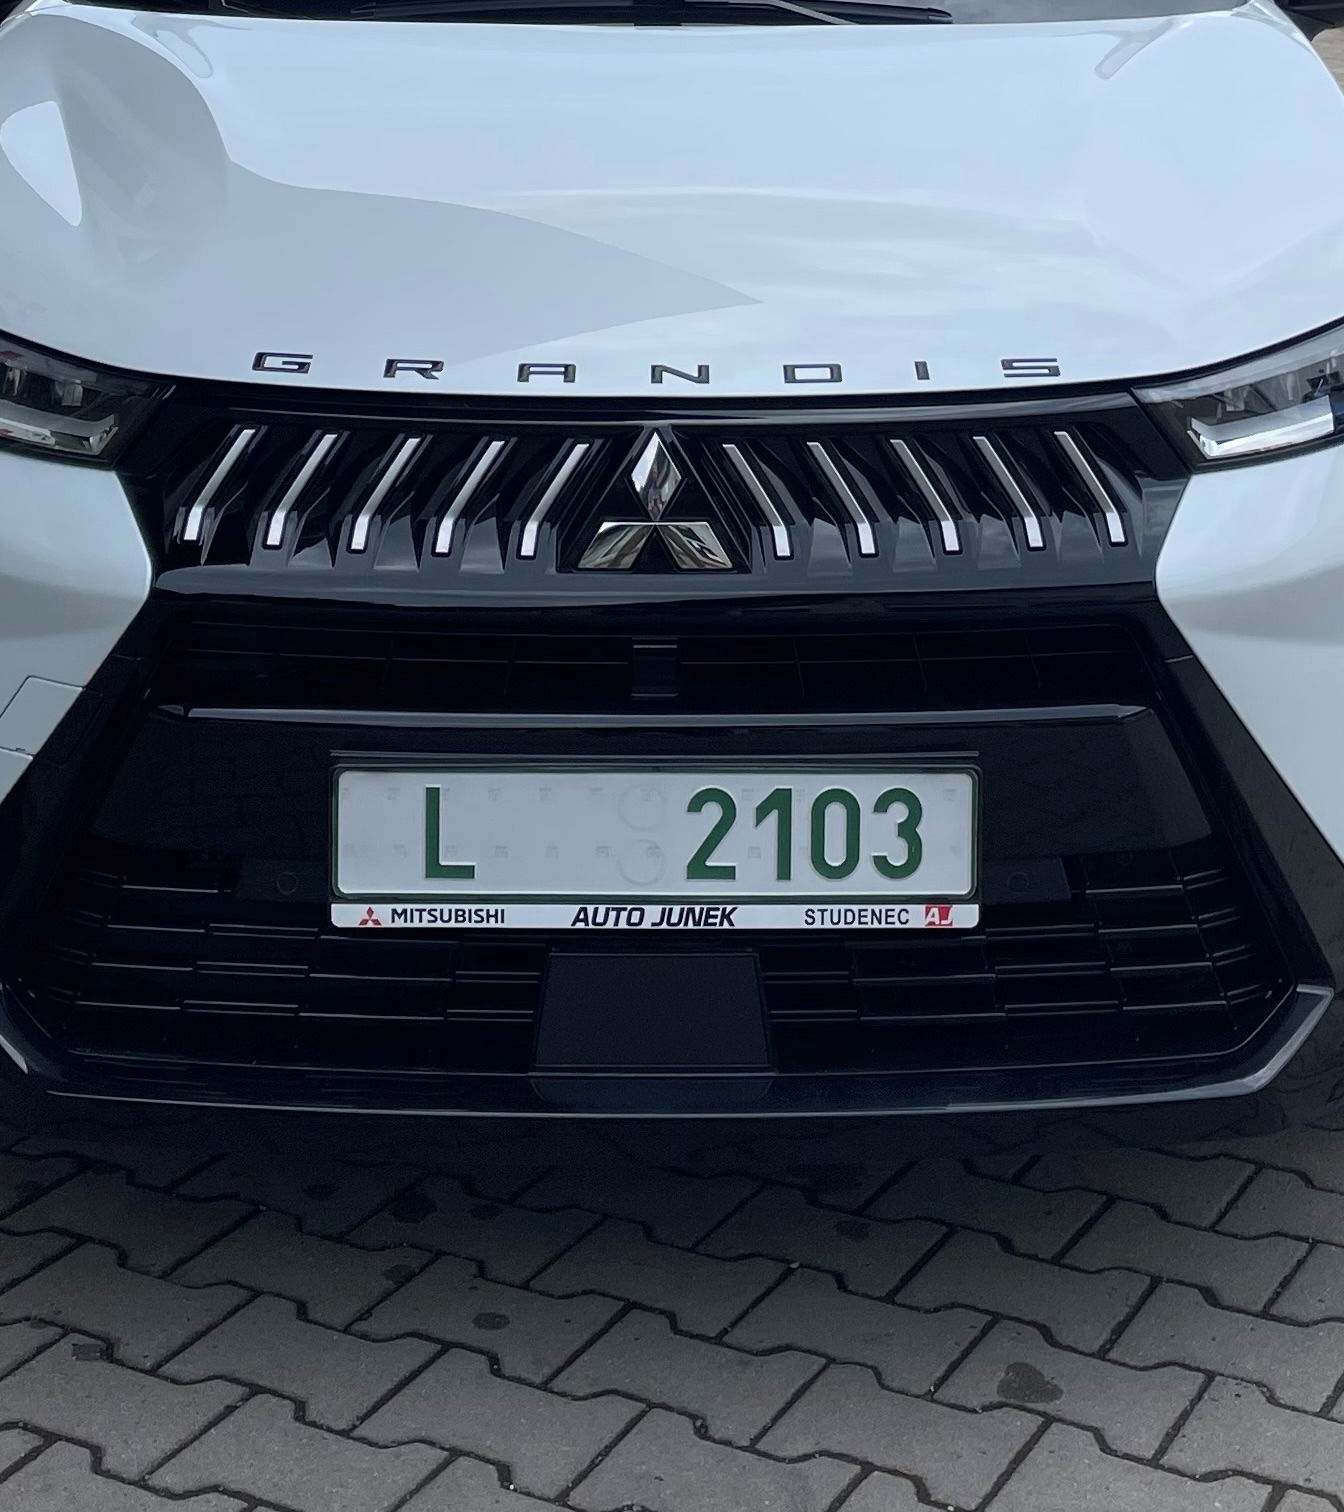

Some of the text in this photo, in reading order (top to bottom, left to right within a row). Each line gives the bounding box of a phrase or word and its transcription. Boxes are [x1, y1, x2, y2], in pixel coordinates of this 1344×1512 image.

[252, 350, 1061, 384] GRANDIS
[424, 786, 923, 880] L 2103
[390, 908, 506, 925] MITSUBISHI
[570, 906, 645, 927] AUTO
[650, 906, 737, 927] JUNEK
[803, 908, 910, 926] STUDENEC
